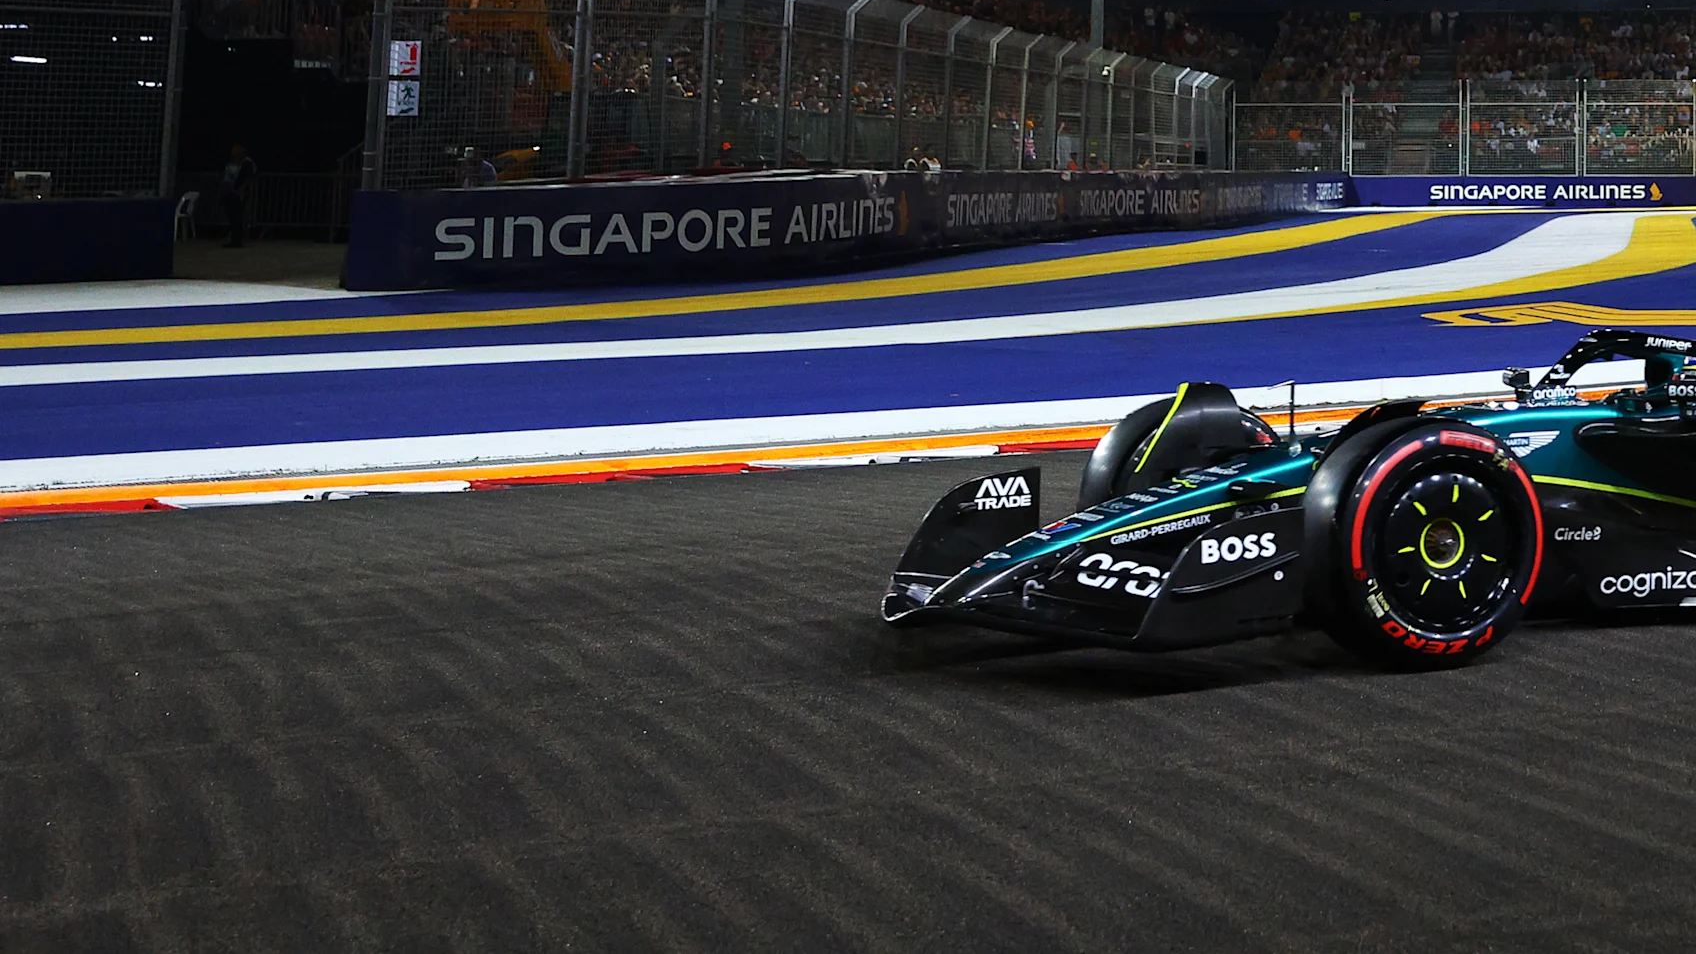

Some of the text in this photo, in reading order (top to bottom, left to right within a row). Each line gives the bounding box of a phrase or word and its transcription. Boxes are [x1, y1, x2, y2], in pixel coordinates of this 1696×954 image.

[1080, 188, 1145, 216] SINGAPORE
[1430, 184, 1646, 200] SINGAPORE AIRLINES
[947, 192, 1058, 227] SINGAPORE AIRLINES
[434, 197, 895, 261] SINGAPORE AIRLINES
[1533, 387, 1576, 400] aramco
[974, 494, 1032, 511] TRADE
[976, 476, 1031, 499] AVA
[1110, 513, 1211, 545] GIRARD-PERREGAUX
[1201, 532, 1277, 564] BOSS
[1381, 619, 1469, 655] ZERO
